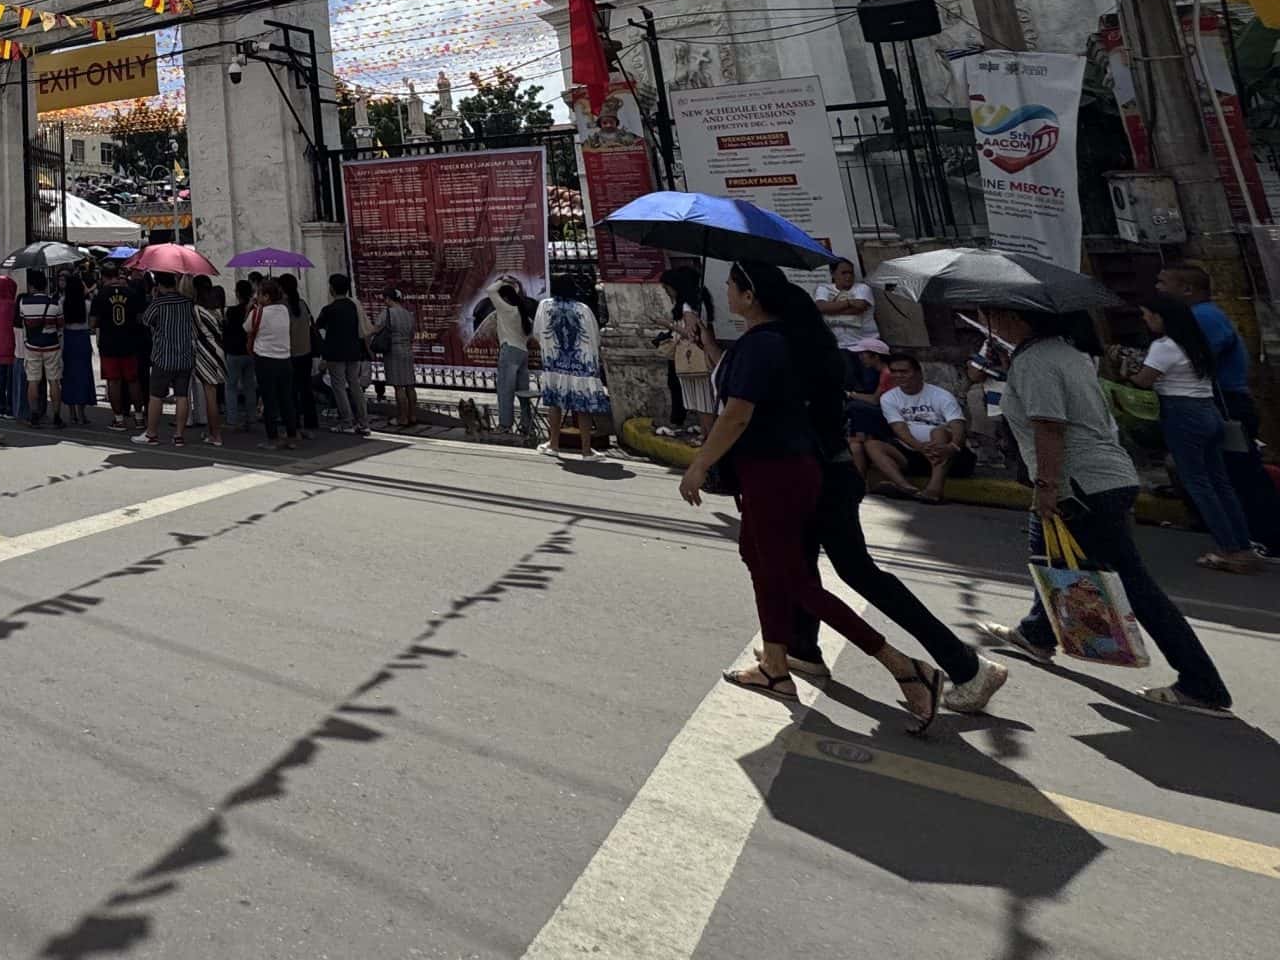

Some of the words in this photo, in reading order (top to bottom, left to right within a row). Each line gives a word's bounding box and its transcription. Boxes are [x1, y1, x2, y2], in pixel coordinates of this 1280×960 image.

[40, 67, 79, 95] EXIT
[87, 54, 150, 86] ONLY
[681, 110, 703, 118] NEW
[705, 104, 758, 116] SCHEDULE
[759, 103, 773, 111] OF
[776, 99, 816, 110] MASSES
[703, 115, 724, 123] AND
[726, 110, 796, 122] CONFESSIONS
[1009, 130, 1031, 140] 5th
[983, 138, 1031, 149] AACOM
[728, 178, 758, 186] FRIDAY
[759, 175, 794, 185] MASSES
[983, 178, 1007, 190] INE
